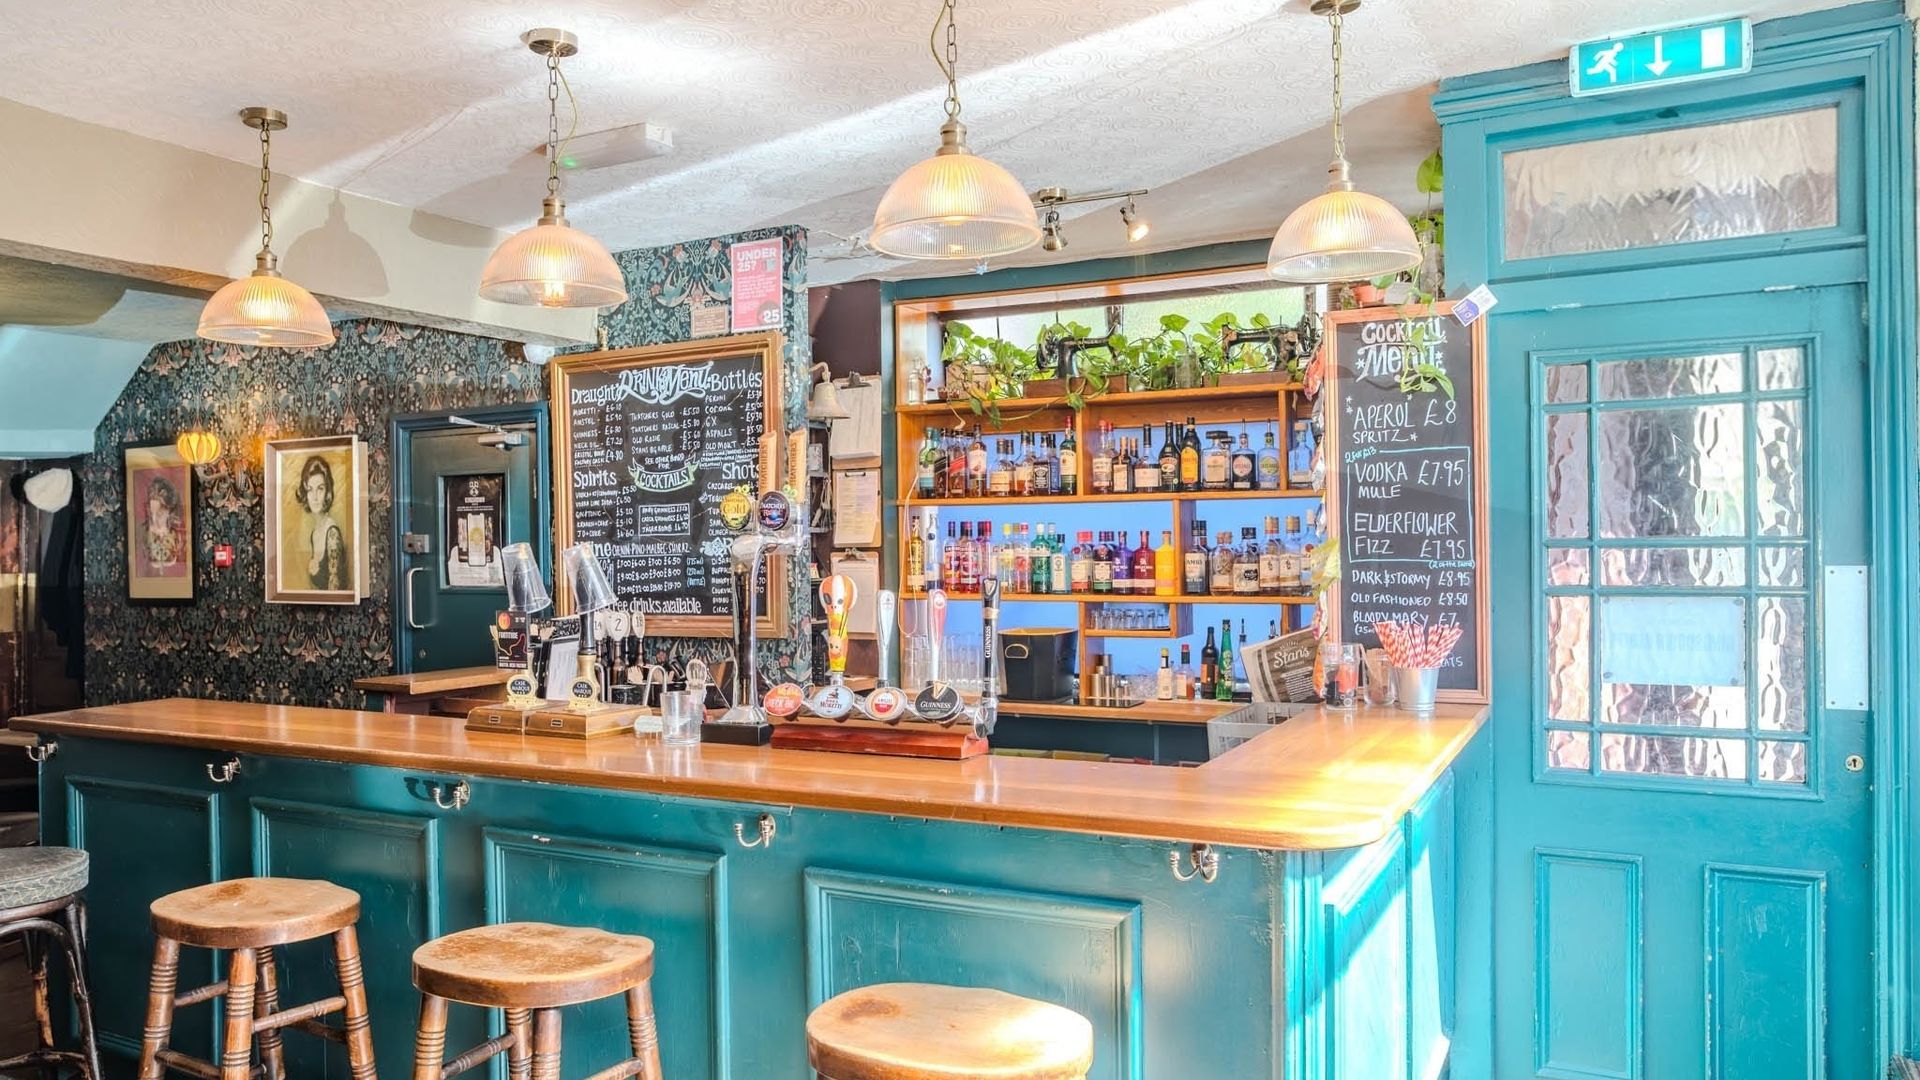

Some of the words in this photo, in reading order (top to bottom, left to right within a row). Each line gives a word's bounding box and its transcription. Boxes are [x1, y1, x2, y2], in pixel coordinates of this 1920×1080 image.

[737, 248, 777, 260] UNDER
[737, 260, 756, 272] 25?
[763, 309, 780, 323] 25
[711, 370, 763, 391] Bottles
[1354, 402, 1415, 430] APEROL
[1424, 399, 1456, 426] £8
[1353, 430, 1409, 444] SPRITZ
[574, 470, 617, 489] Spirits
[640, 470, 688, 489] COCKTAILS
[1355, 462, 1408, 483] VODKA
[1358, 484, 1401, 499] MULE
[1354, 512, 1458, 536] ELDERFLOWER
[1355, 536, 1394, 556] FIZZ
[1352, 570, 1381, 585] DARK
[629, 597, 661, 613] drinks
[662, 597, 702, 613] available
[1351, 592, 1370, 603] OLD
[1373, 593, 1431, 607] FASHIONED
[615, 618, 622, 631] 2
[1392, 611, 1429, 629] MARY
